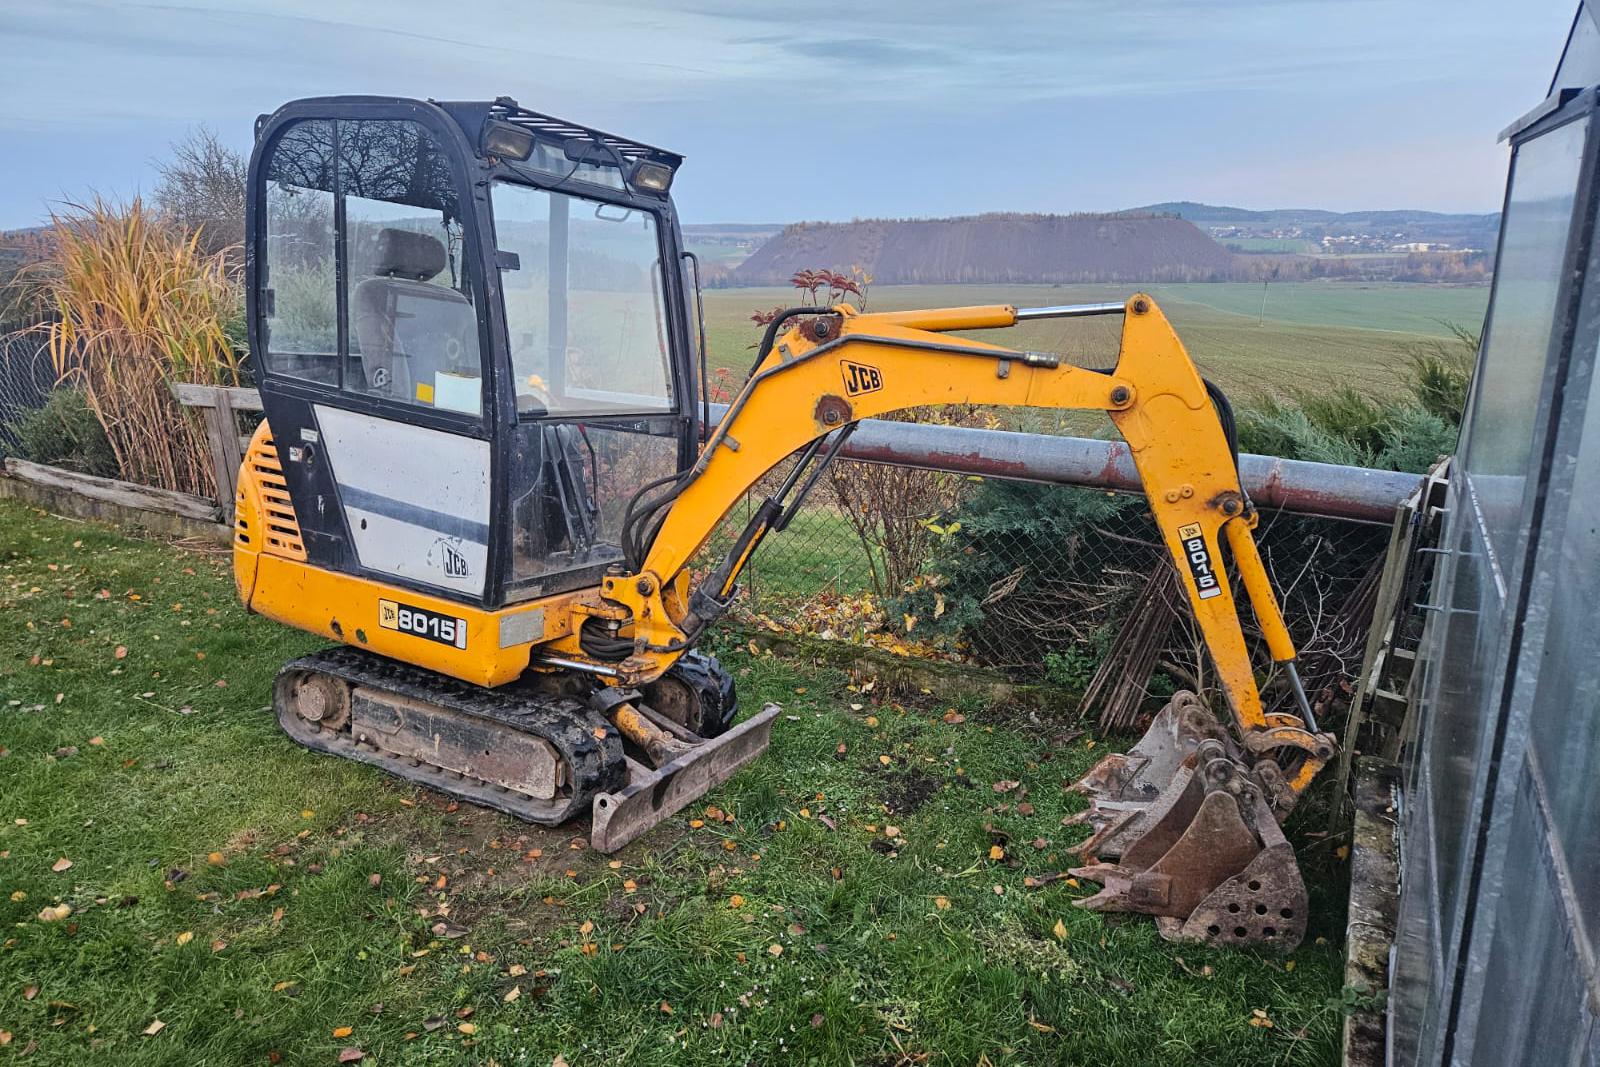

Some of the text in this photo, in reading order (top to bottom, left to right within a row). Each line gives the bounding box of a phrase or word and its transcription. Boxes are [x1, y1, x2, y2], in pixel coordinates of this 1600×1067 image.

[848, 364, 881, 393] JCB
[445, 547, 467, 576] JCB
[1187, 538, 1215, 588] 8015
[398, 609, 455, 641] 8015
